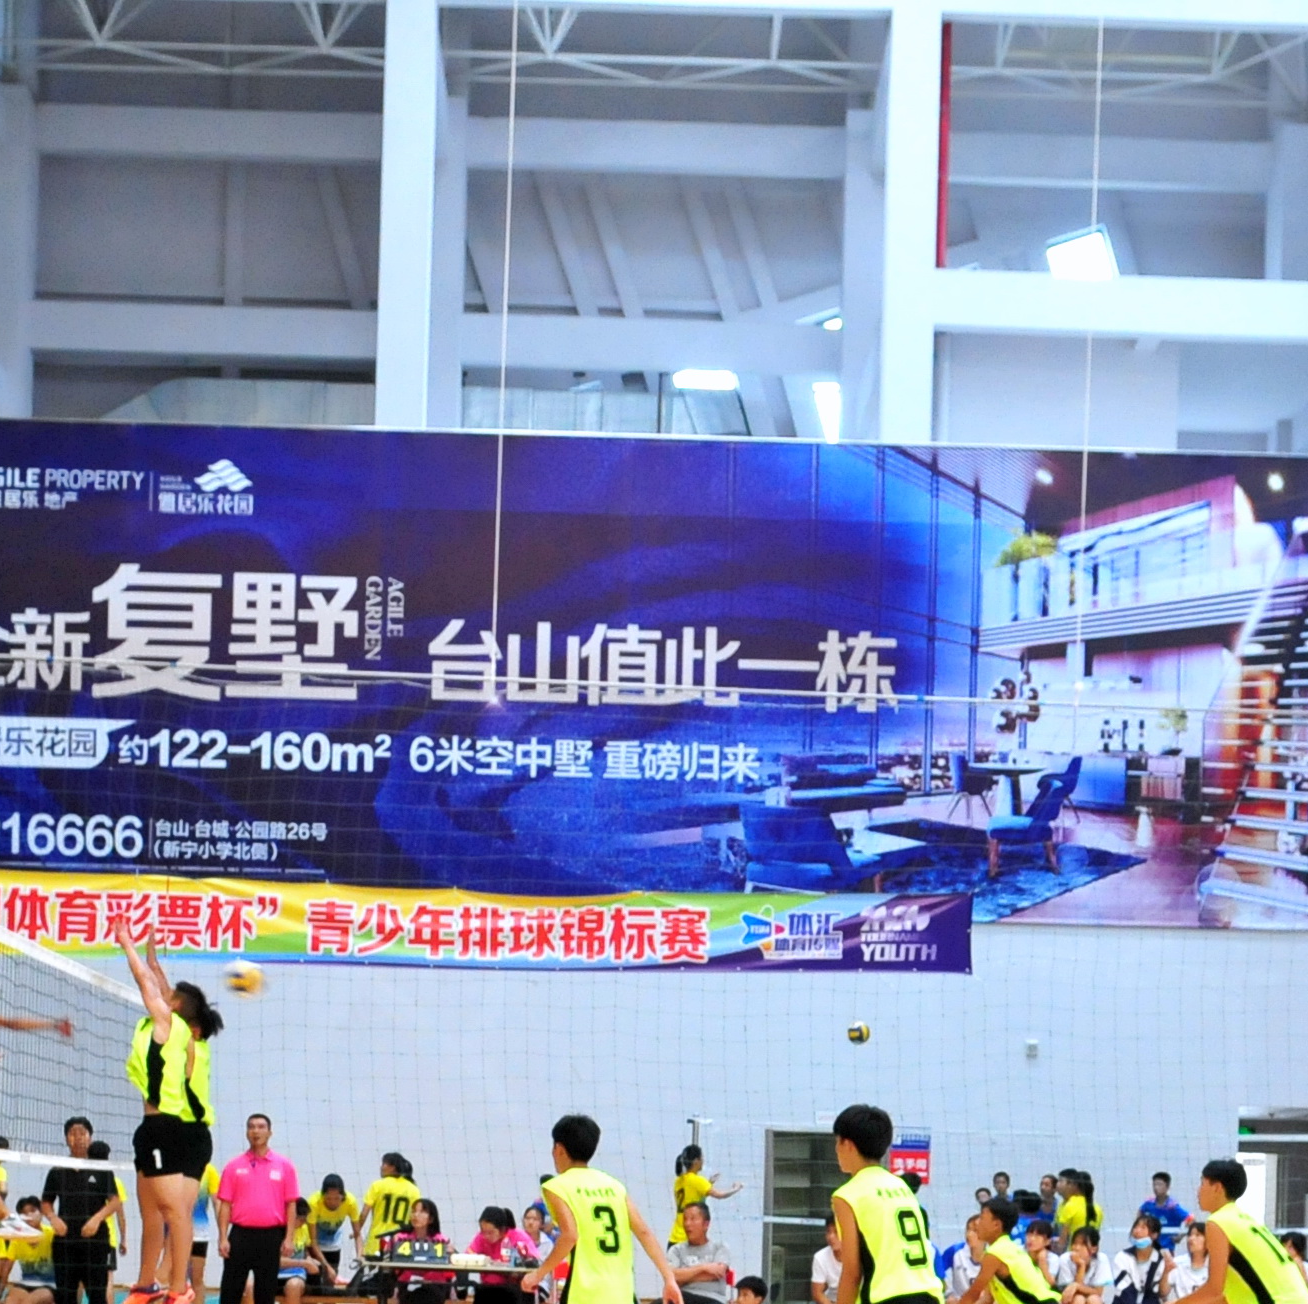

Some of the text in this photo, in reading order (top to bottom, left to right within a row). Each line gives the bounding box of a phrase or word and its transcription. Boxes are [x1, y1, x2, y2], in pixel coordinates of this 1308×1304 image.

[44, 468, 146, 492] PROPERTY
[365, 576, 382, 661] GARDEN
[387, 577, 405, 638] AGILE
[427, 619, 900, 714] 台山值此一栋
[408, 735, 594, 779] 6米空中墅
[603, 740, 761, 784] 重磅归来
[306, 900, 710, 962] 青少年排球锦标赛
[860, 943, 938, 962] YOUTH
[152, 1148, 163, 1170] 1
[381, 1192, 413, 1226] 10
[593, 1205, 620, 1254] 3
[896, 1208, 929, 1268] 9
